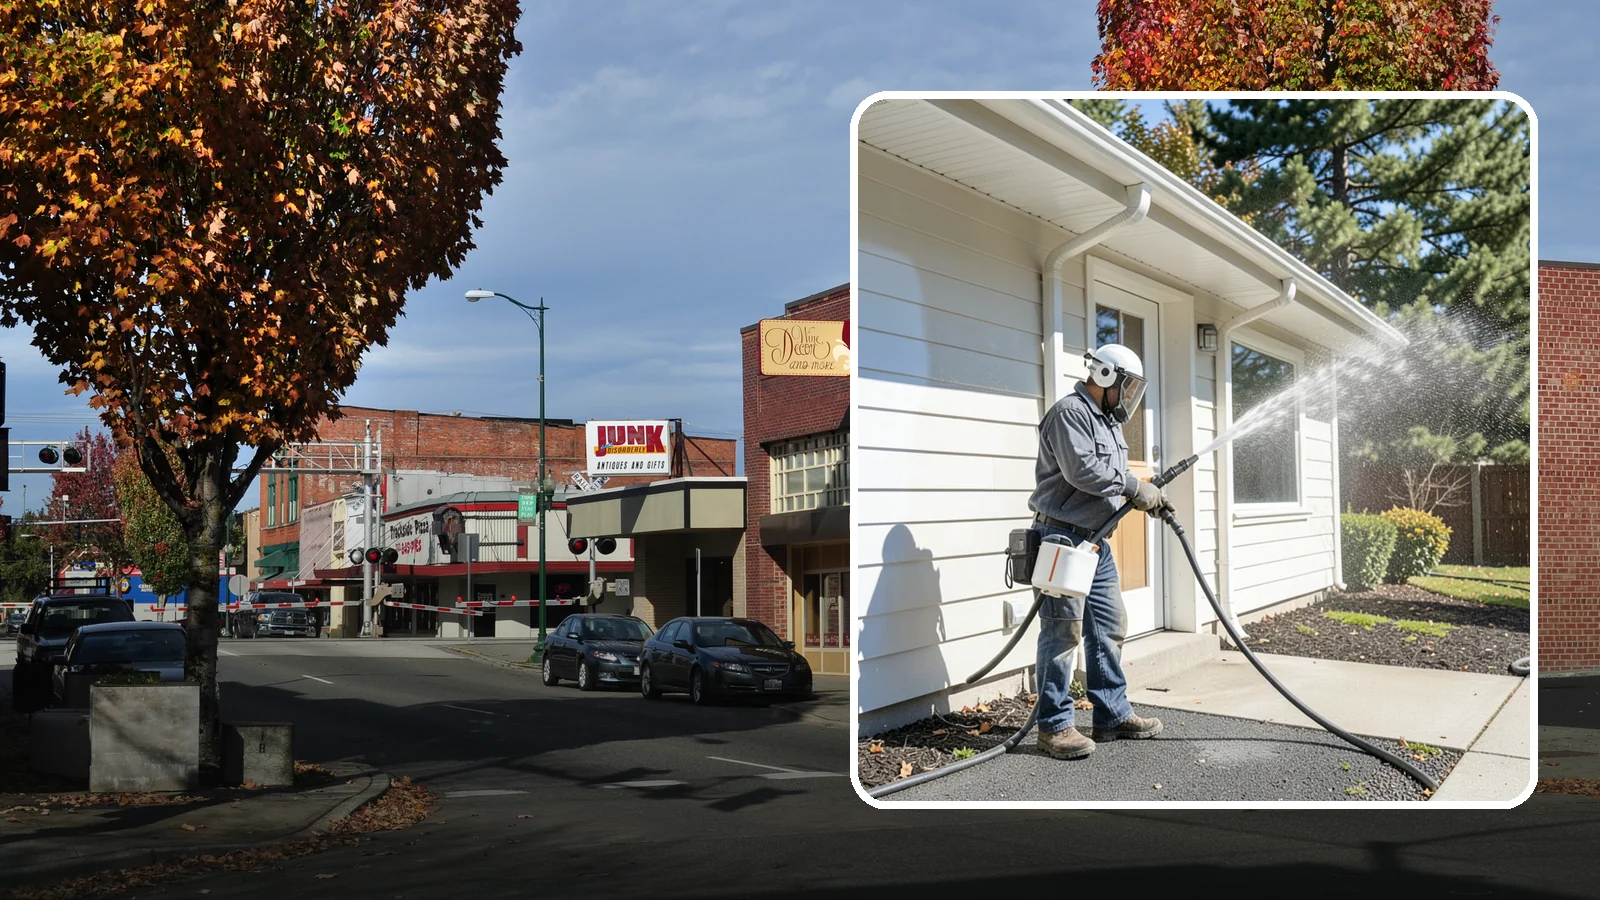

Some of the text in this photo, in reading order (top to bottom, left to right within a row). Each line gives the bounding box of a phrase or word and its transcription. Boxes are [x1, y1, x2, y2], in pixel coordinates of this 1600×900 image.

[595, 425, 666, 457] JUNK
[607, 446, 646, 454] DISORDERLY
[597, 461, 666, 470] ANTIQUES AND GIFTS
[390, 519, 429, 540] Trackside Pizza
